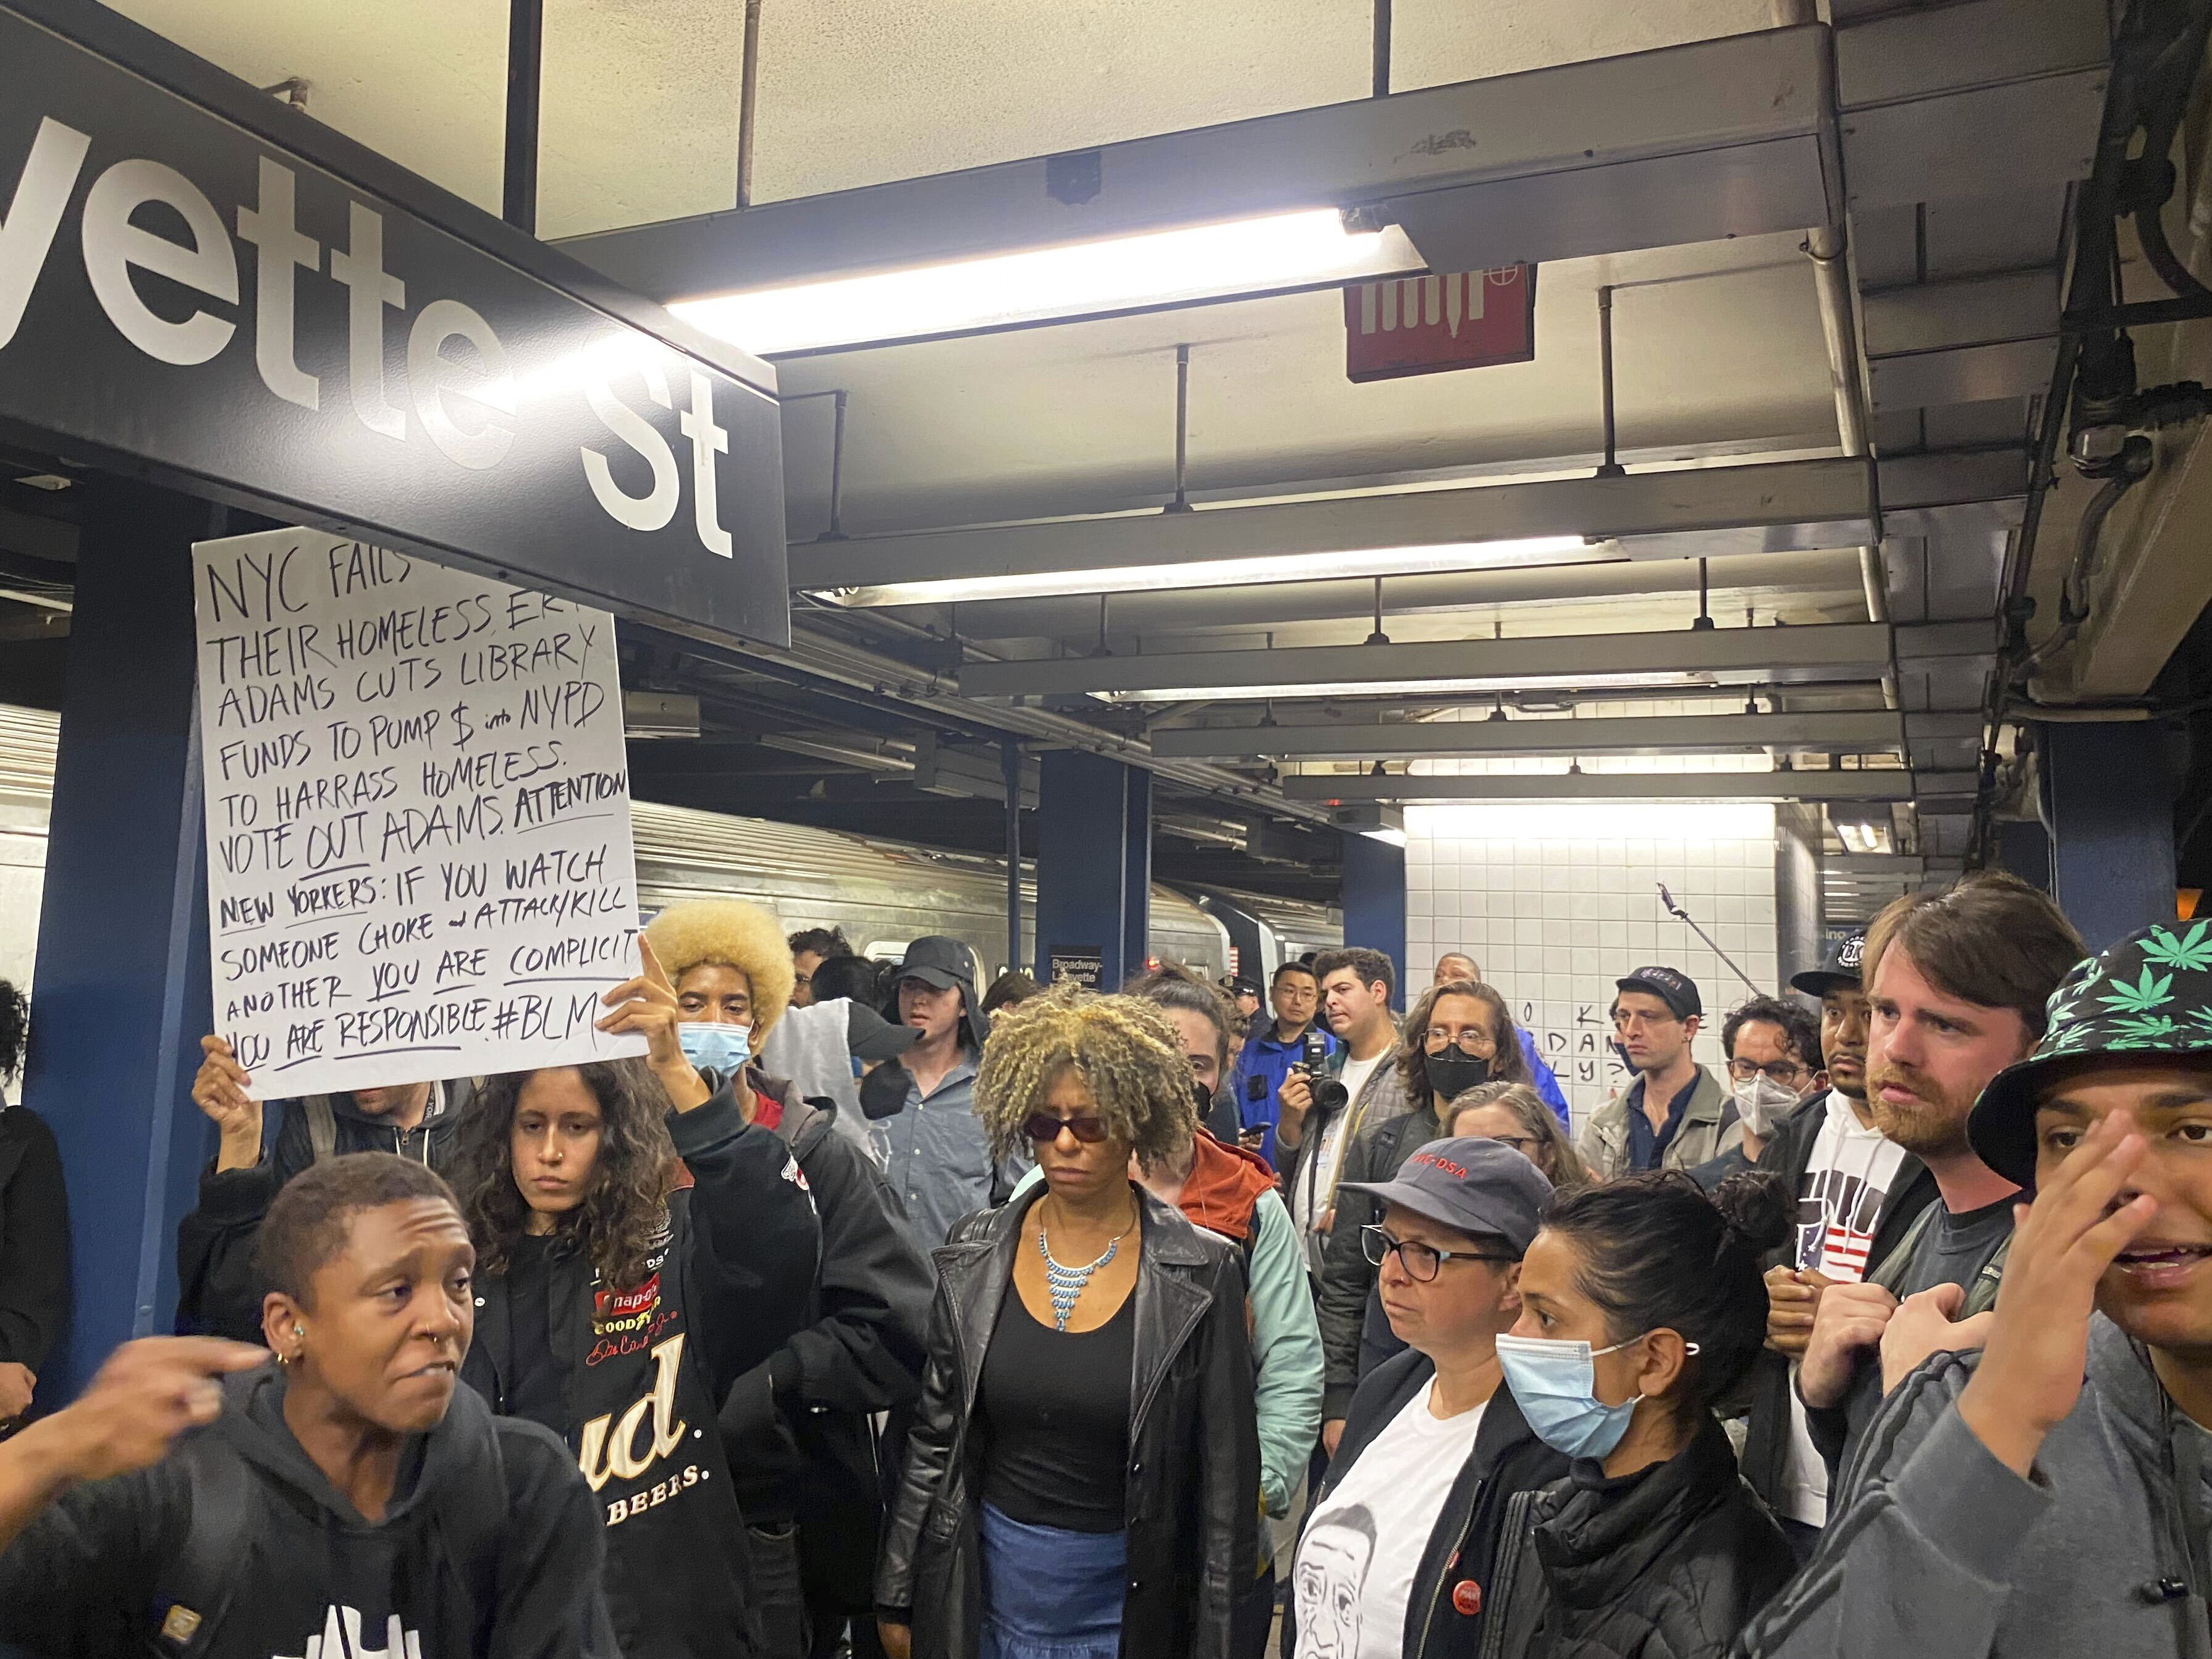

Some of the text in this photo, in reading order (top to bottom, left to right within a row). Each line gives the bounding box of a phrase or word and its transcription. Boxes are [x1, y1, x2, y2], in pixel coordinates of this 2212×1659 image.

[580, 363, 734, 560] St
[207, 542, 411, 622] NYC FAILS
[206, 624, 337, 685] THEIR
[218, 623, 595, 728] ADAMS CUTS LIBRARY
[219, 730, 311, 780] FUNDS
[327, 720, 361, 761] TO
[369, 709, 440, 756] PUMP
[450, 701, 474, 751] $
[520, 681, 604, 730] NYPD
[219, 741, 567, 827] TO HARRASS HOMELESS.
[219, 769, 626, 874] VOTE OUT ADAMS. ATTENTION
[220, 844, 607, 929] NEW YORKERS: IF YOU WATCH
[221, 932, 339, 981] SOMEONE
[358, 913, 434, 955] CHOKE
[474, 886, 627, 928] ATTACK/KILL
[227, 929, 638, 1022] ANOTHER YOU ARE COMPLICIT
[1052, 971, 1096, 983] Layette
[287, 1018, 326, 1058] ARE
[491, 991, 598, 1052] #BLM
[1527, 1032, 1620, 1055] DAN
[606, 1464, 699, 1527] BEERS
